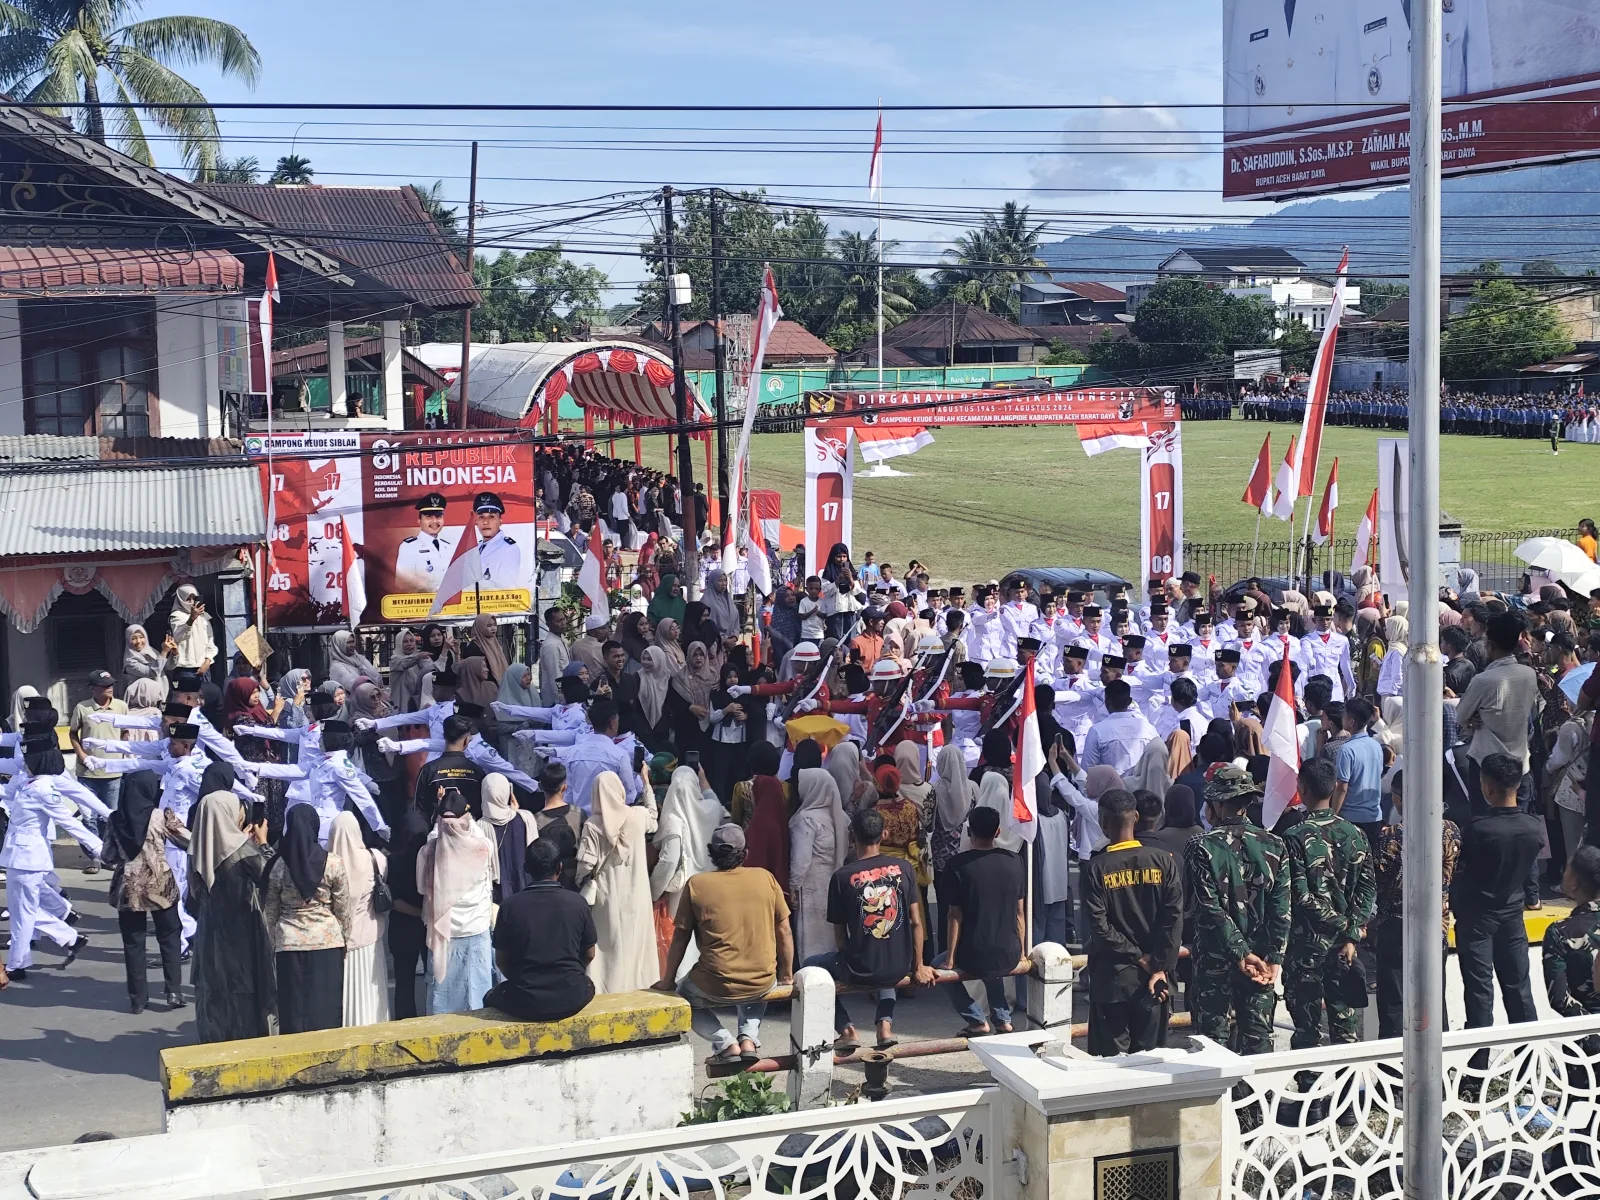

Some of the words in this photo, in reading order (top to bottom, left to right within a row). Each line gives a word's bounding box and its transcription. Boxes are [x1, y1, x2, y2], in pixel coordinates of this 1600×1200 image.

[1361, 133, 1395, 154] ZAMAN
[1231, 158, 1241, 174] Dr.
[1243, 149, 1297, 172] SAFARUDDIN,
[1370, 160, 1390, 171] WAKIL
[1391, 156, 1411, 168] BUPAT
[1441, 149, 1457, 161] ARAT
[1458, 147, 1476, 159] DAYA
[1255, 177, 1275, 187] BUPATI
[1275, 174, 1291, 184] ACEH
[1291, 171, 1311, 182] BARAT
[1311, 168, 1326, 178] DAYA
[1047, 391, 1136, 402] INDONESIA
[937, 405, 975, 413] AGUSTUS
[1014, 404, 1051, 412] AGUSTUS
[1053, 404, 1072, 412] 2026
[881, 416, 911, 424] GAMPONG
[956, 415, 991, 423] KECAMATAN
[993, 414, 1028, 422] BLANGPIDIE
[264, 439, 303, 448] GAMPONG
[304, 439, 328, 448] KEUDE
[329, 438, 357, 447] SIBLAH
[405, 444, 517, 467] REPUBLIK
[323, 472, 341, 491] 17
[406, 465, 517, 486] INDONESIA
[1154, 491, 1170, 510] 17
[821, 502, 839, 521] 17
[1151, 554, 1172, 574] 08
[268, 573, 291, 591] 45
[1103, 870, 1128, 890] PENCAK
